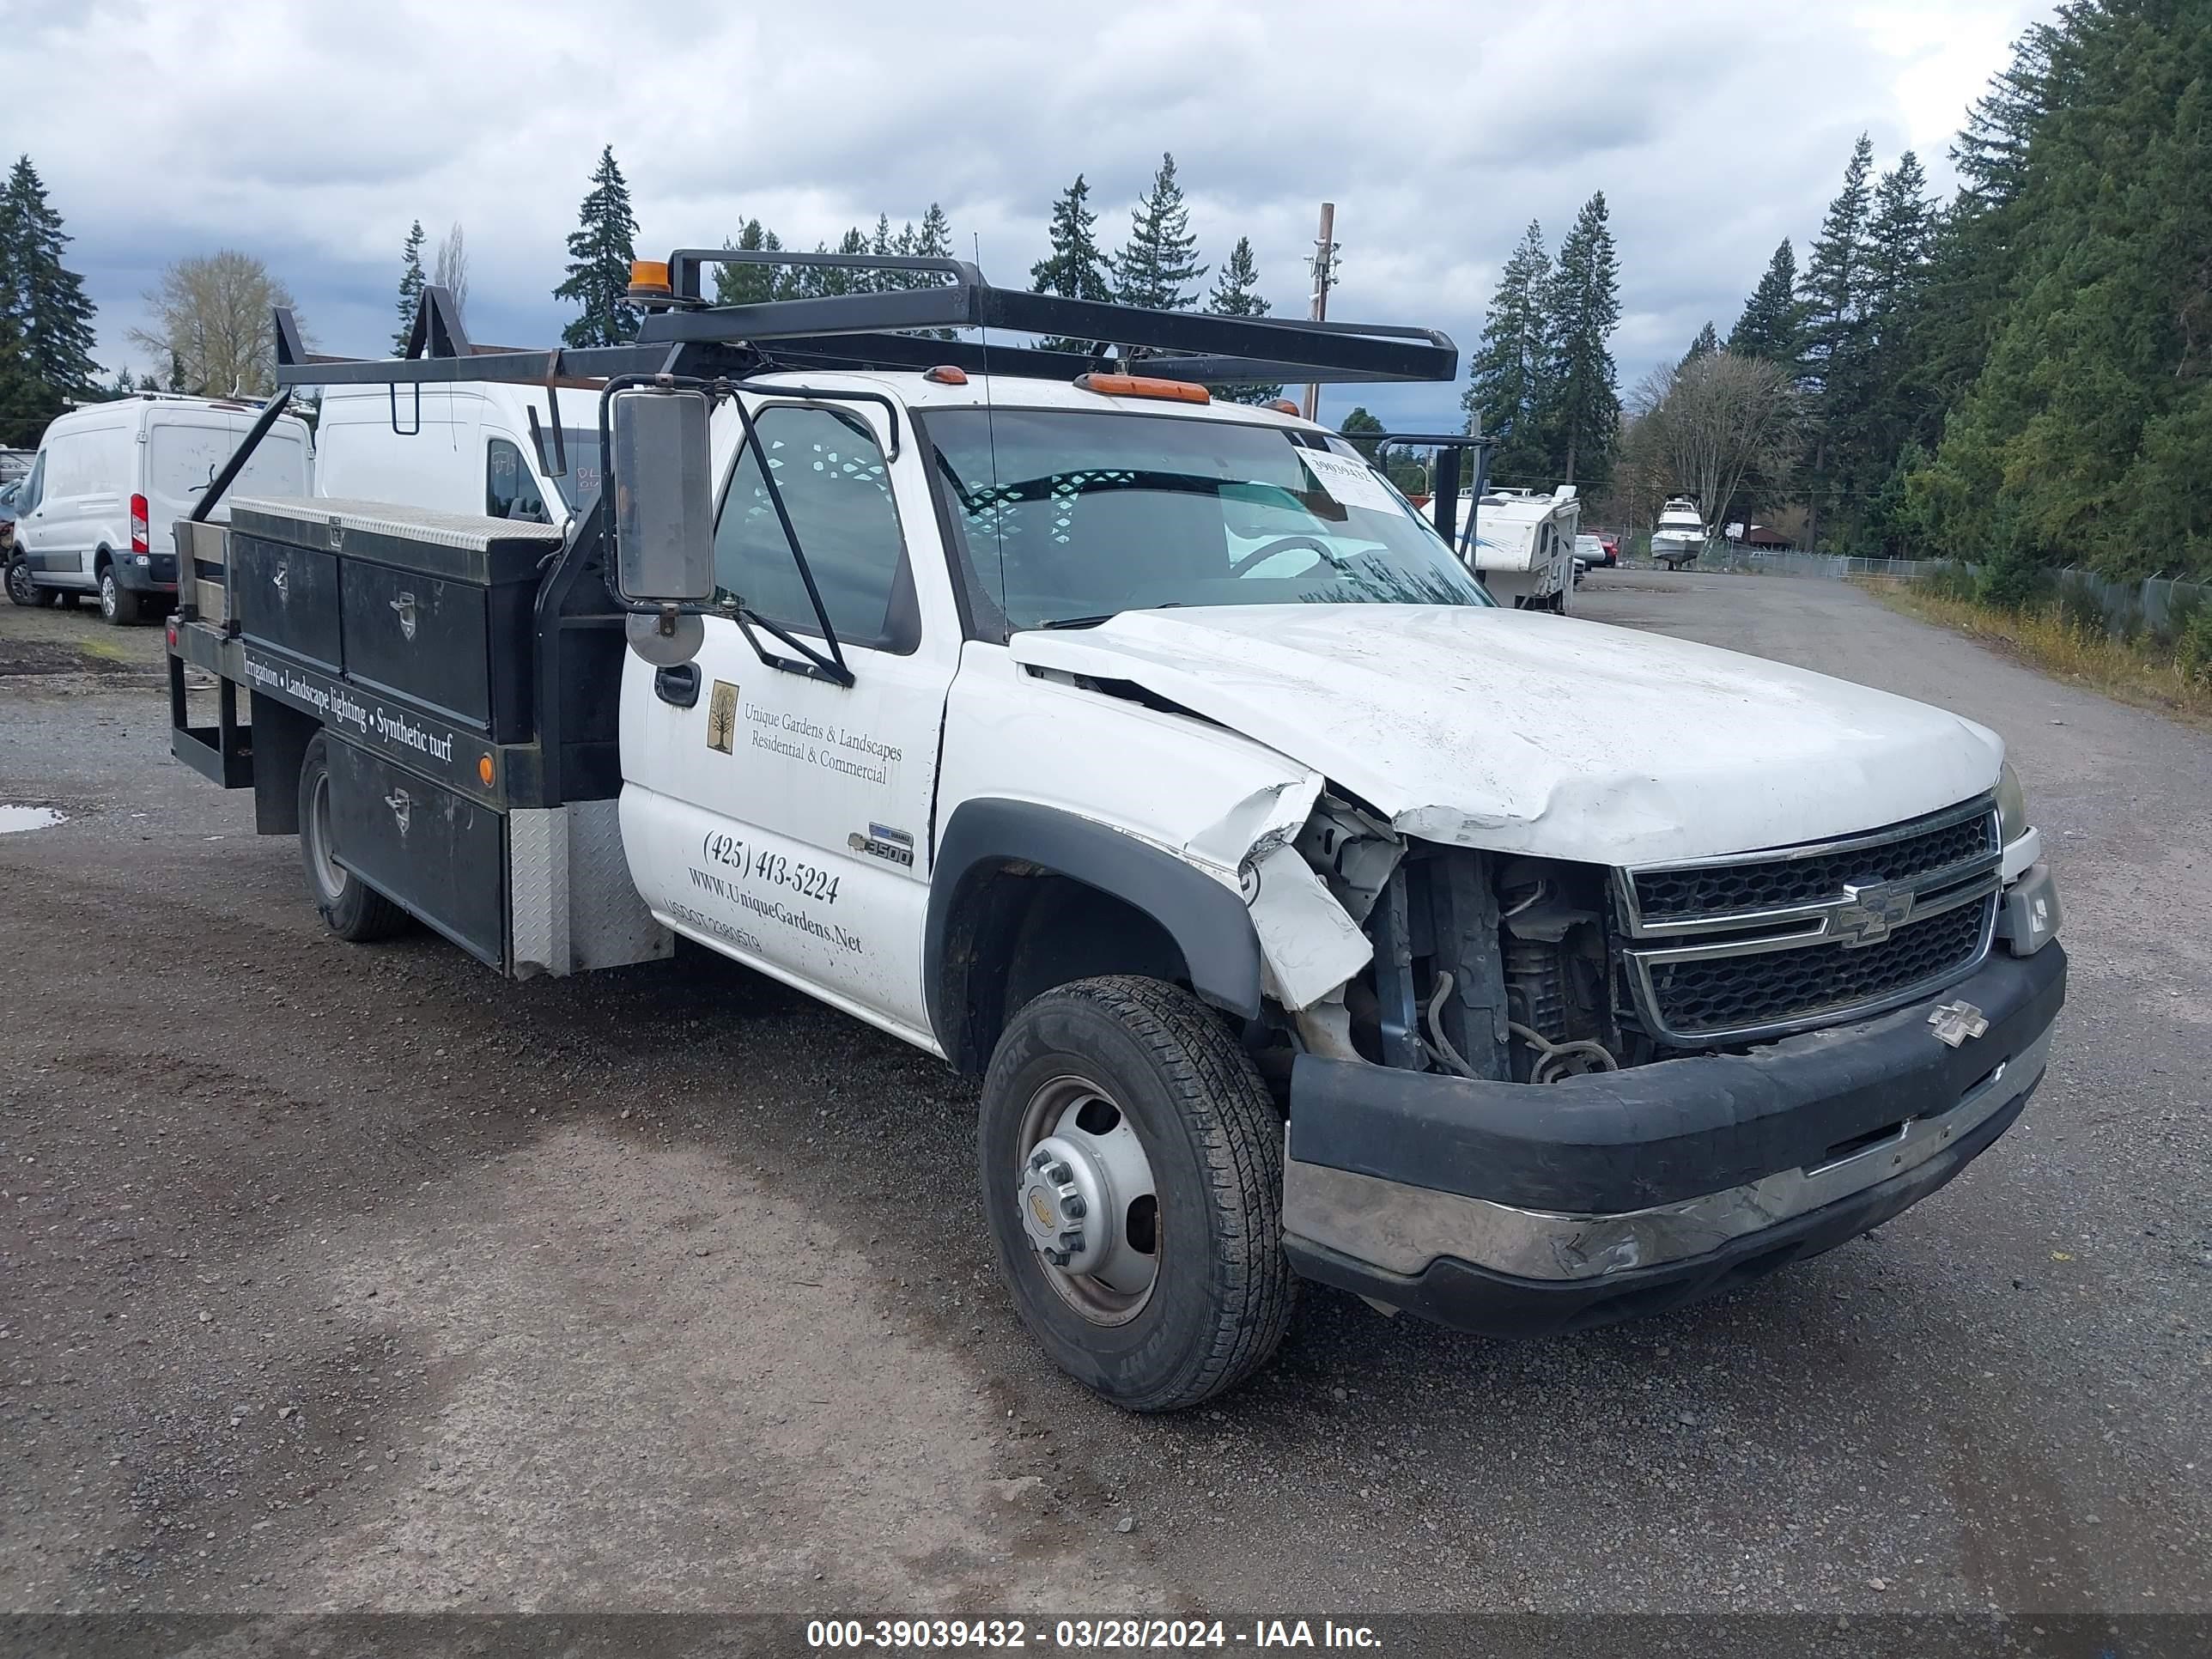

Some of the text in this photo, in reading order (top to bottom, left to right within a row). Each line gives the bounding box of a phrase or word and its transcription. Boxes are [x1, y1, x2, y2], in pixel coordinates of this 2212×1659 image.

[244, 652, 453, 763] Irrigation Landscape lighting Synthetic turf
[744, 702, 902, 763] Unique Gardens & Landscapes
[751, 729, 887, 785] Residential & Commercial
[702, 830, 842, 905] (425) 413-5224
[867, 841, 911, 866] 3500
[664, 897, 763, 952] USDOT 2380579
